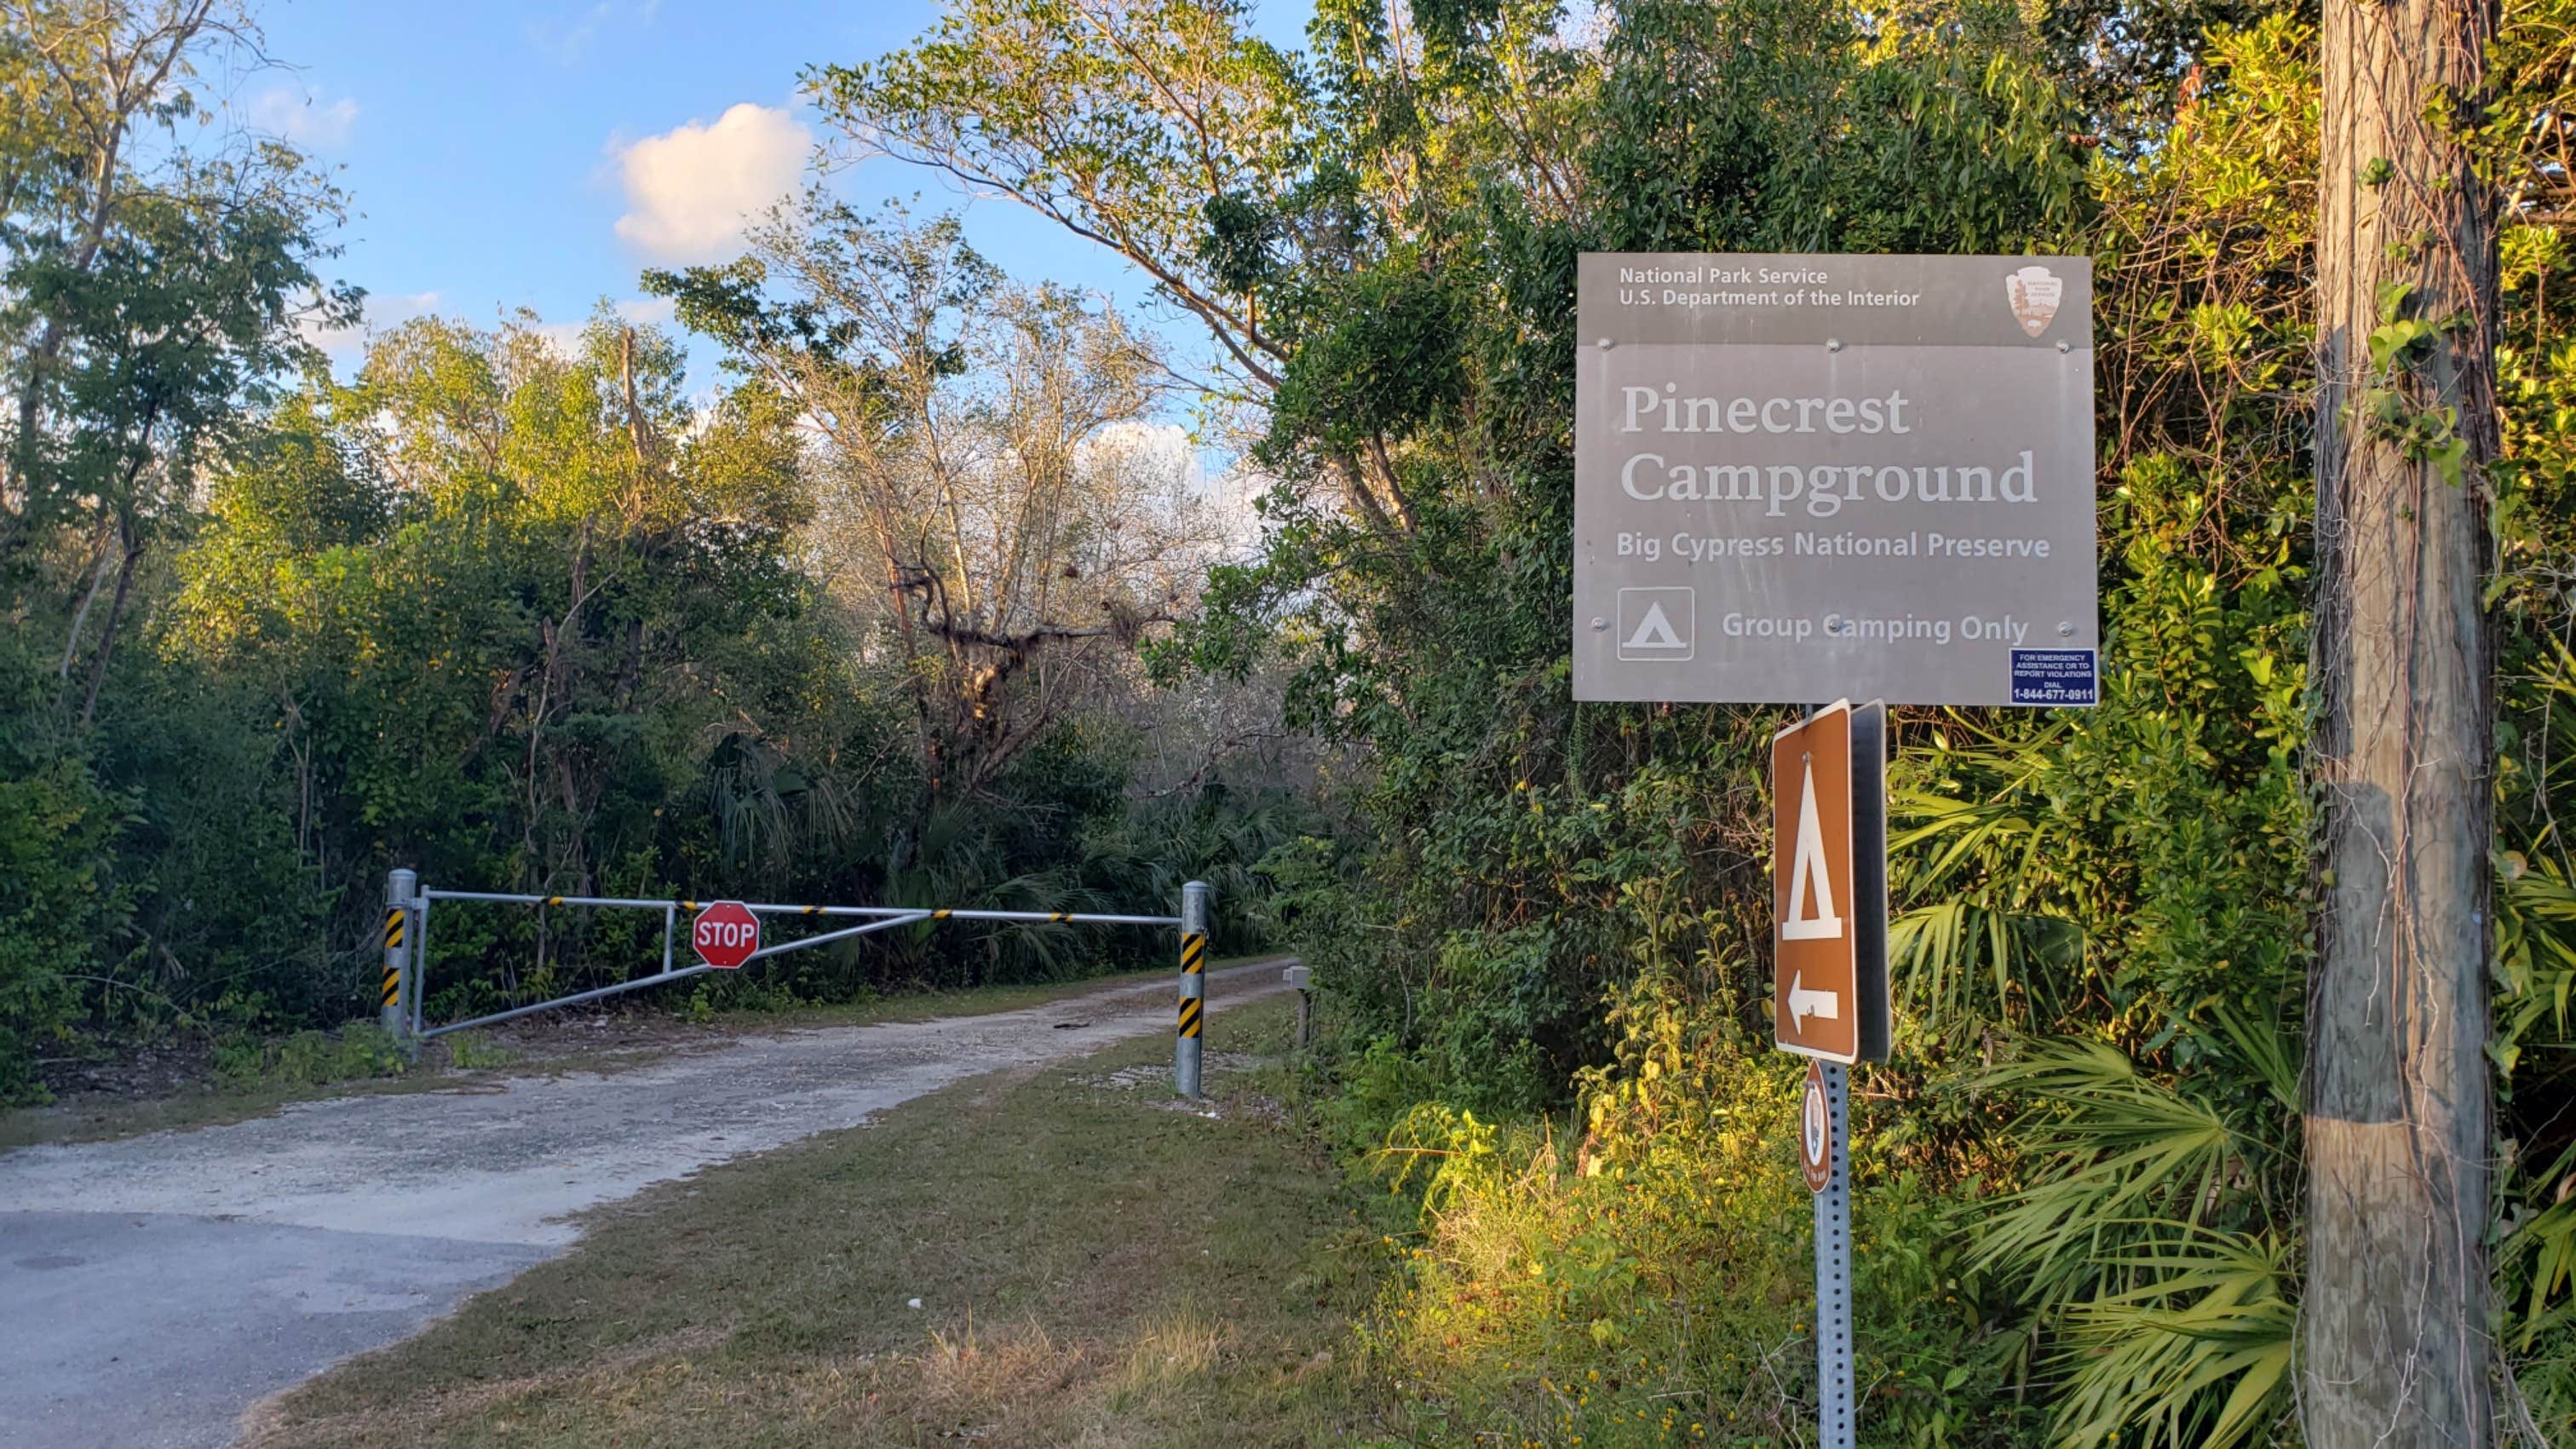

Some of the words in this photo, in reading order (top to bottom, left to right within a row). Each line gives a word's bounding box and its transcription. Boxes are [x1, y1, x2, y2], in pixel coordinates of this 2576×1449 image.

[1619, 266, 1703, 284] National
[1709, 267, 1752, 284] Park
[1758, 267, 1828, 285] Service
[1619, 289, 1656, 305] U.S.
[1663, 289, 1779, 310] Department
[1783, 288, 1805, 306] of
[1809, 289, 1842, 306] the
[1848, 290, 1920, 307] Interior
[1621, 382, 1911, 434] Pinecrest
[1621, 450, 2038, 518] Campground
[1617, 532, 1660, 562] Big
[1671, 532, 1784, 563] Cypress
[1795, 531, 1917, 556] National
[1928, 532, 2050, 558] Preserve
[1722, 612, 1813, 644] Group
[1823, 612, 1951, 645] Camping
[1960, 614, 2029, 647] Only
[2014, 688, 2094, 699] 1-844-677-0911
[698, 922, 755, 948] STOP
